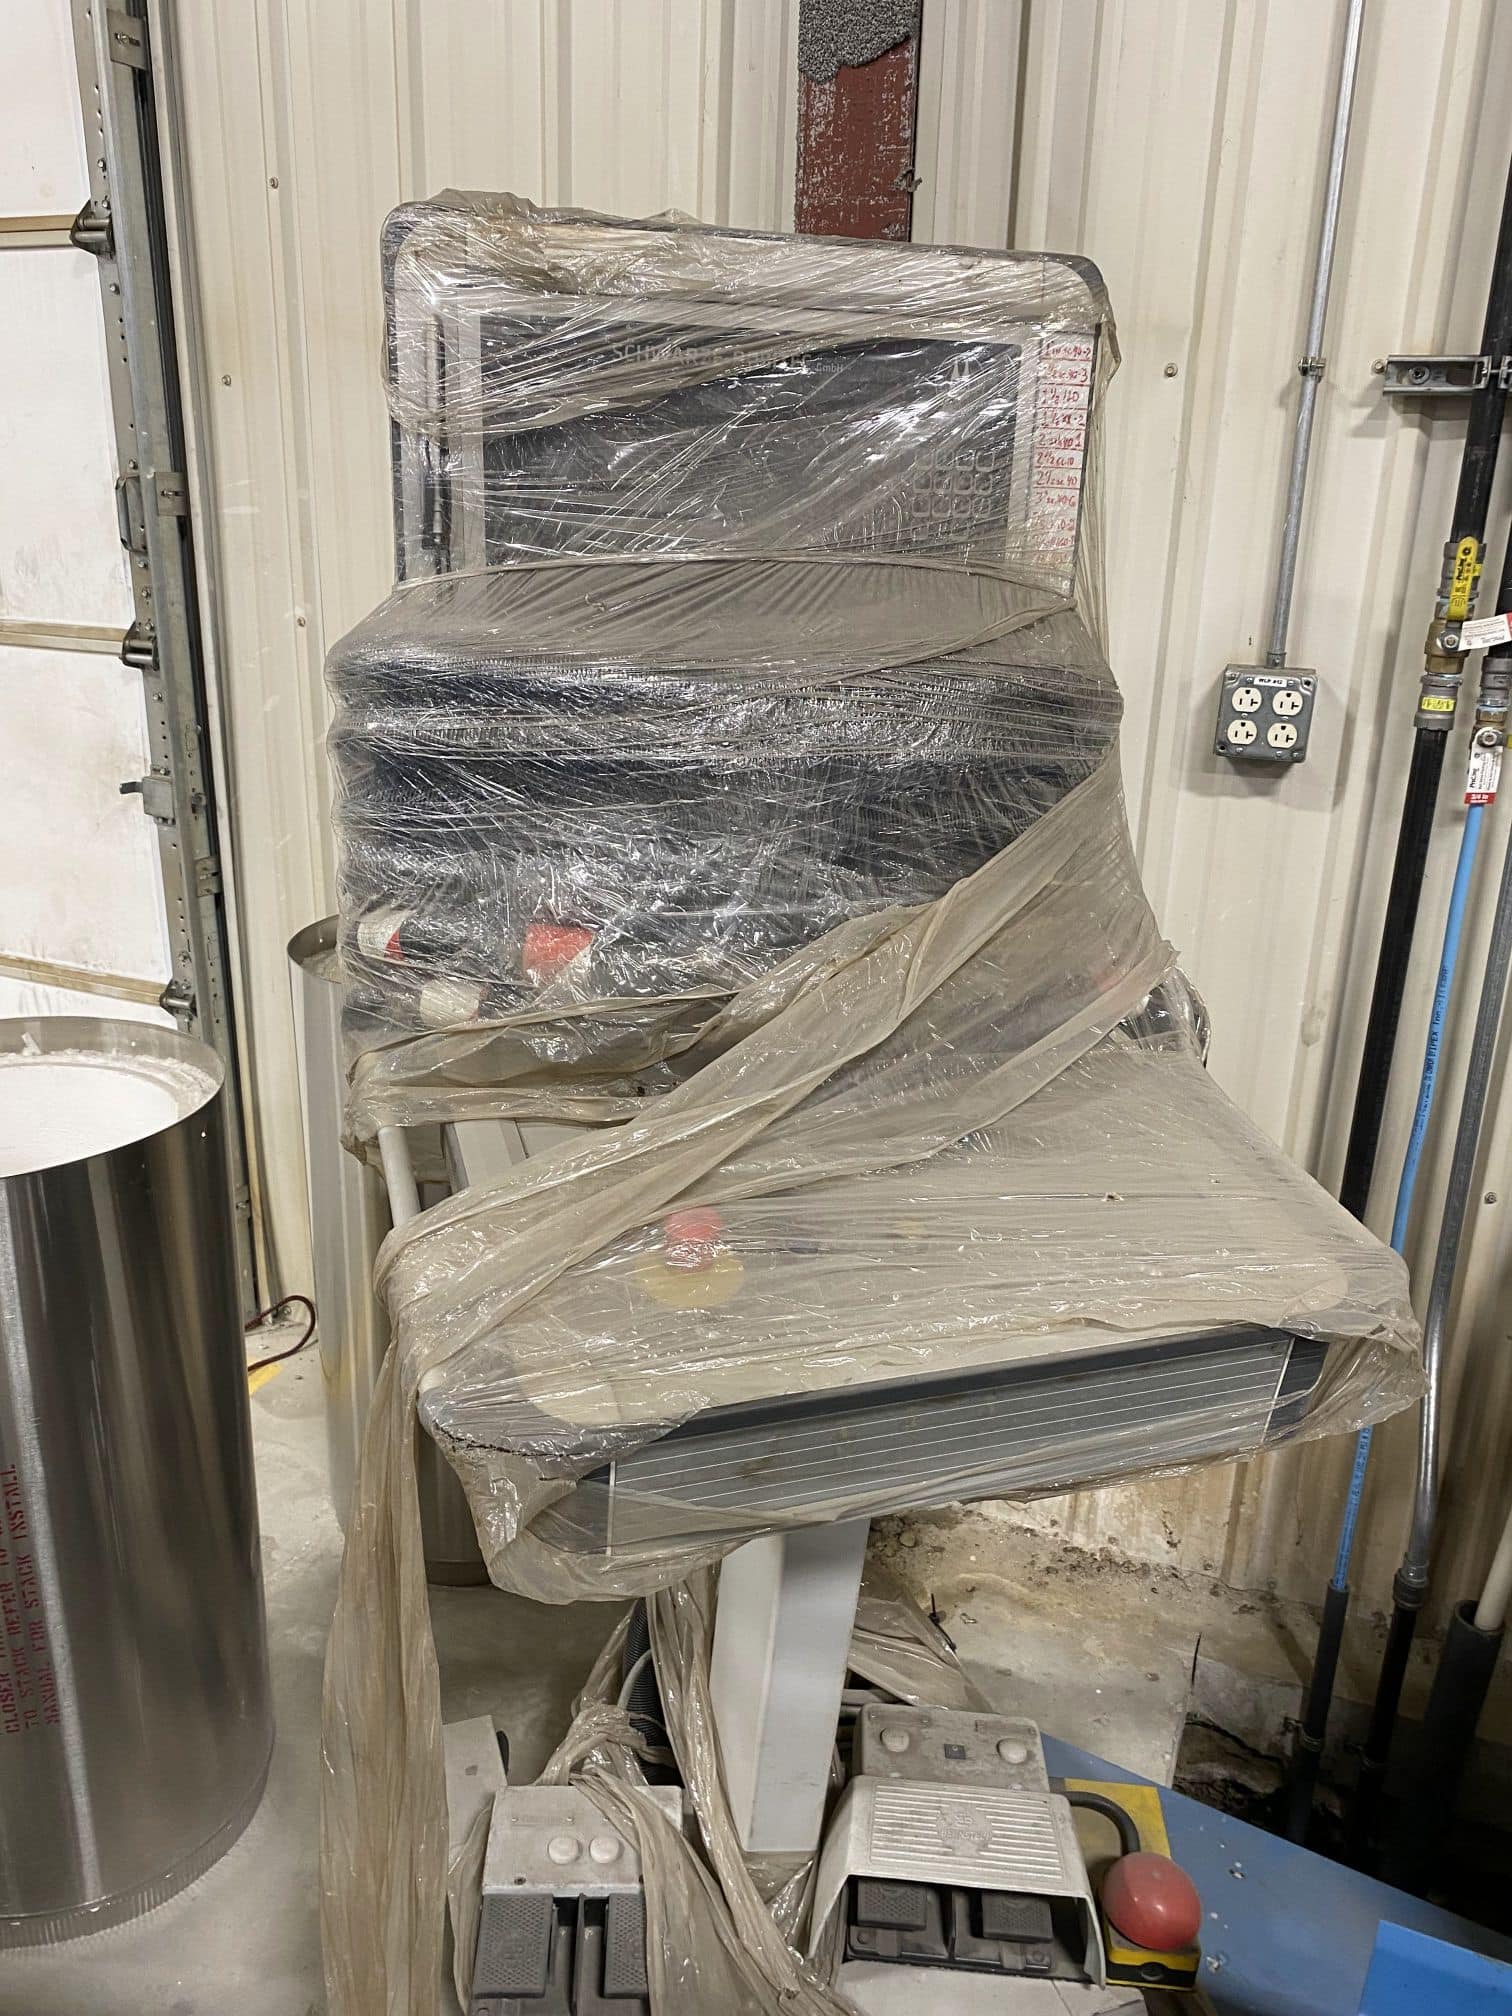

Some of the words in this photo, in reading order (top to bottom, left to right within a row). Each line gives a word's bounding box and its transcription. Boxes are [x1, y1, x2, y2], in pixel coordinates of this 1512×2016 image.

[16, 1553, 40, 1609] STACK
[0, 1582, 21, 1636] REFER
[28, 1620, 46, 1653] FOR
[11, 1647, 34, 1698] STACK
[0, 1671, 20, 1733] CLOSER
